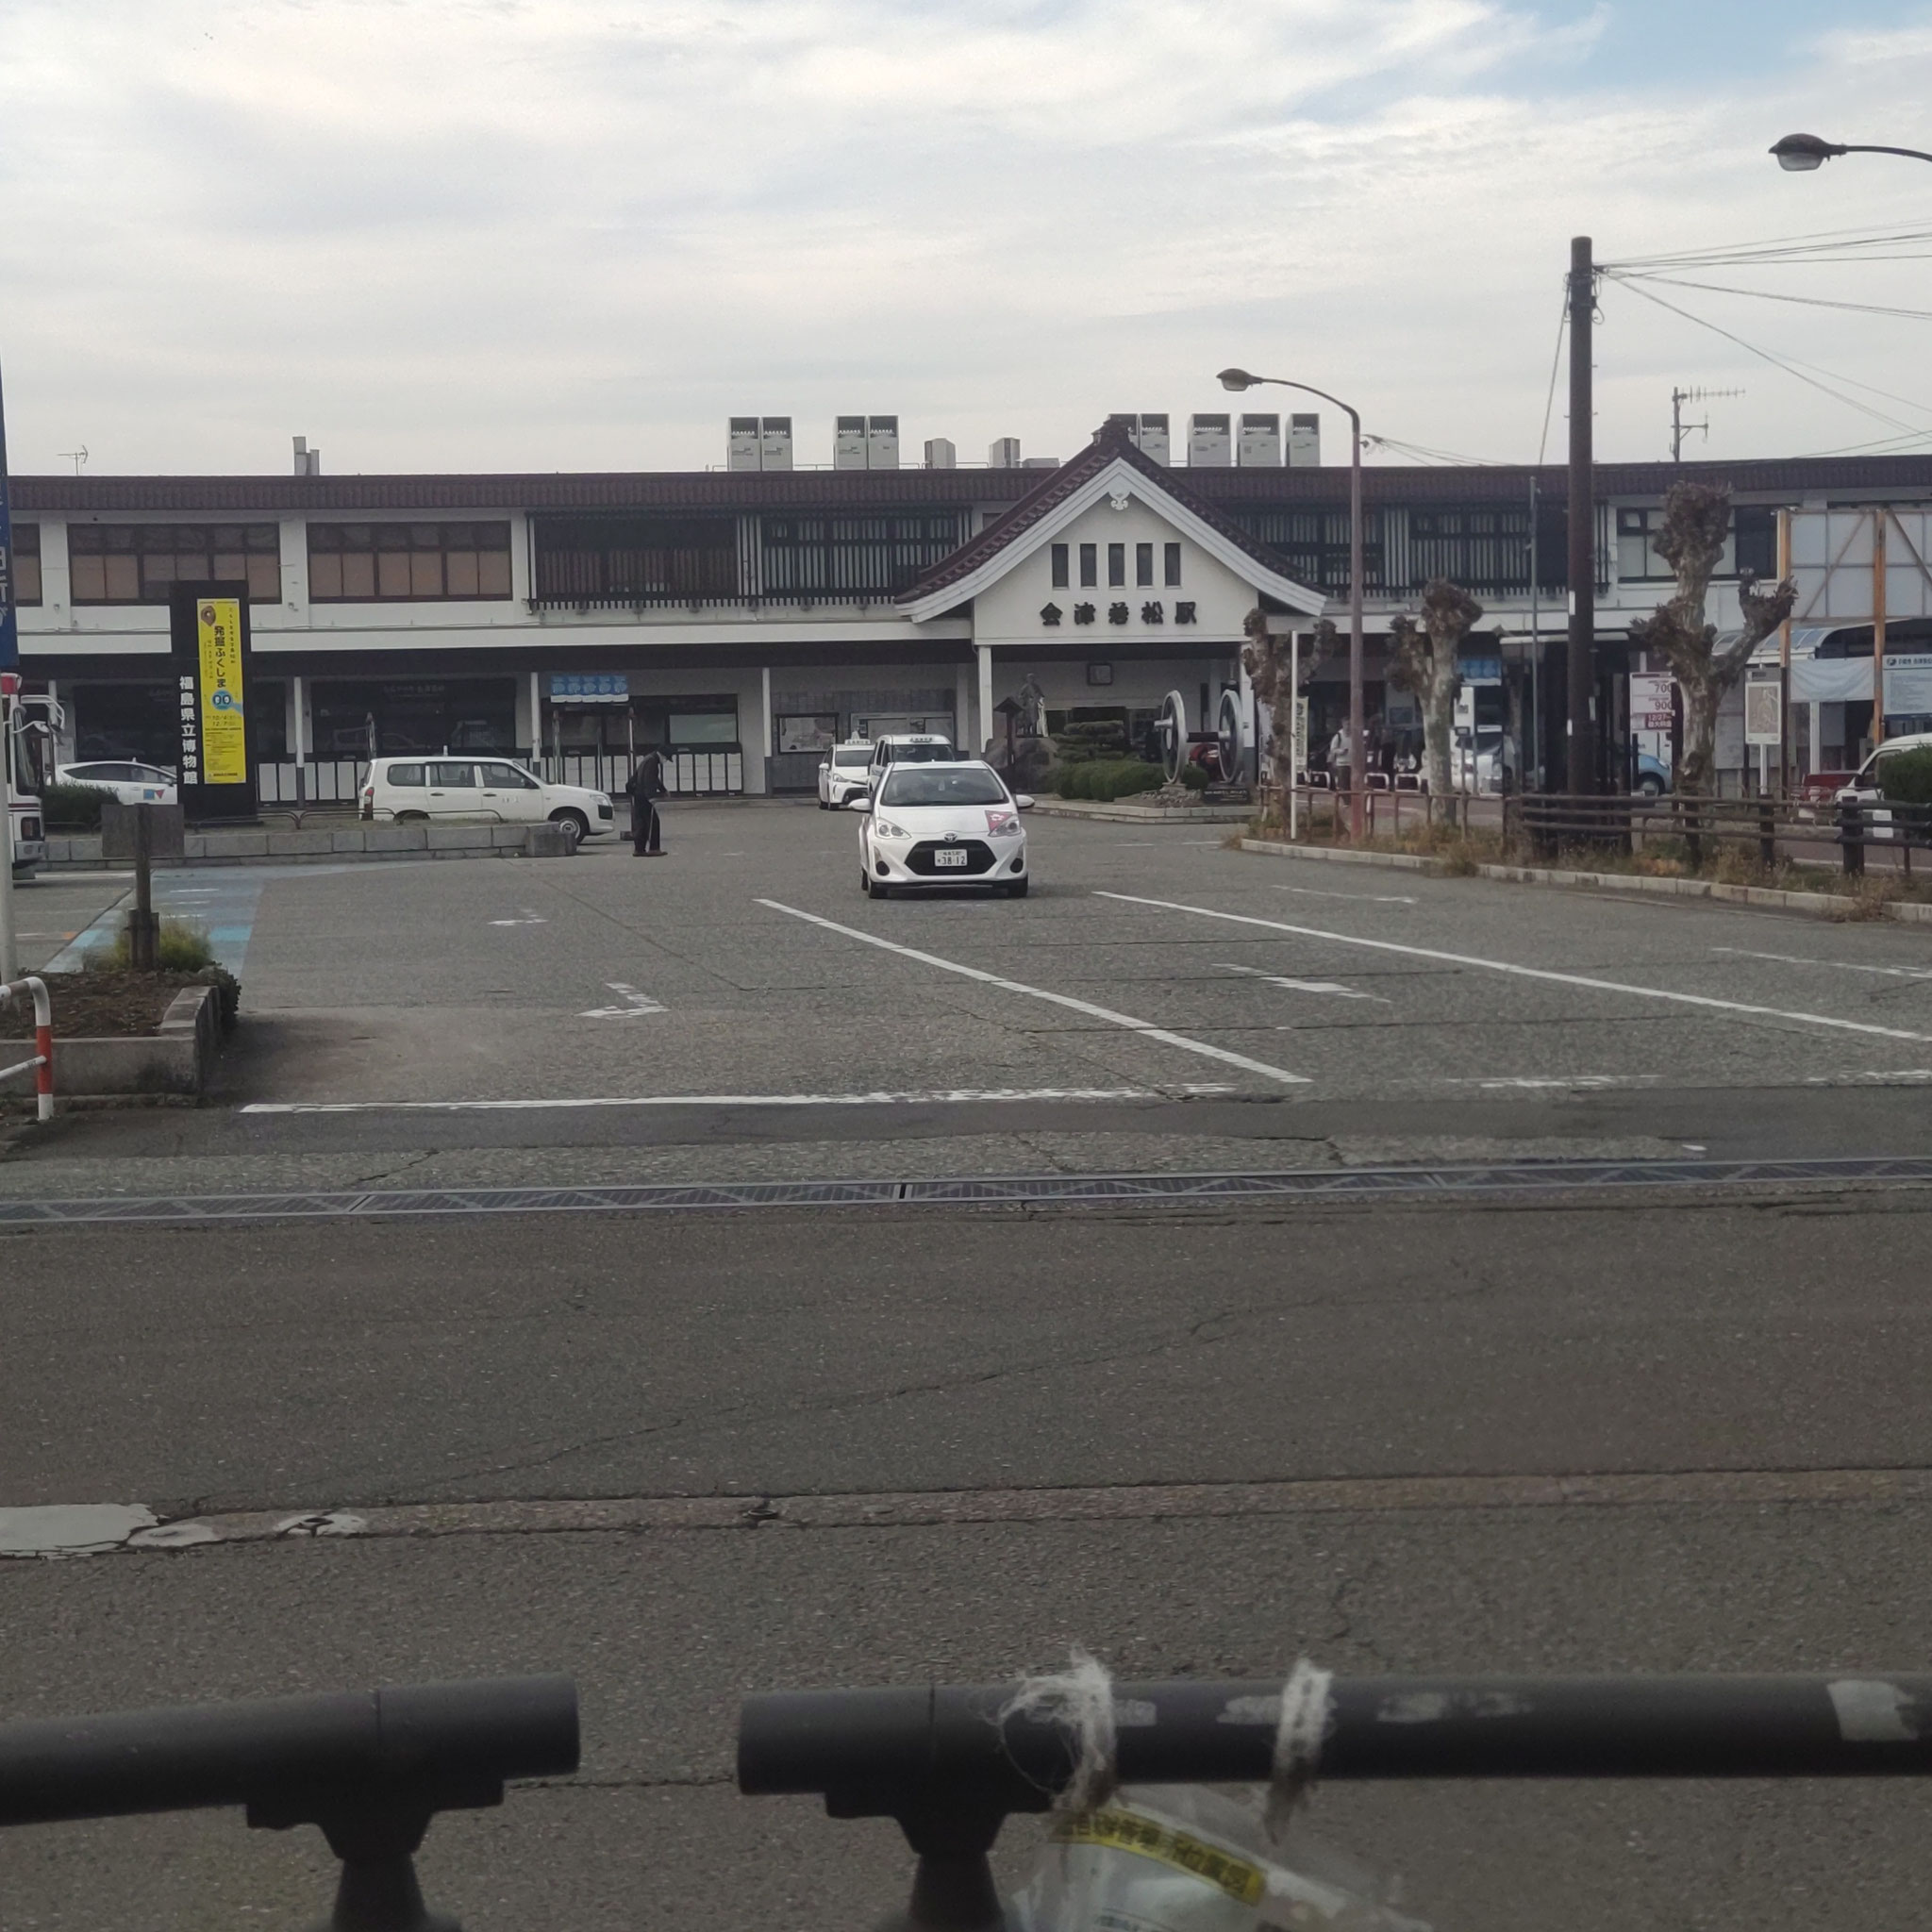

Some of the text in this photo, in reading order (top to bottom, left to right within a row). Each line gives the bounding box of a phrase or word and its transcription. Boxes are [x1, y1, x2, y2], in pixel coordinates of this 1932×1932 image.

[1040, 601, 1197, 625] 会津若松駅
[214, 625, 226, 688] 発掘ふくしま
[179, 675, 198, 784] 福島県立博物館
